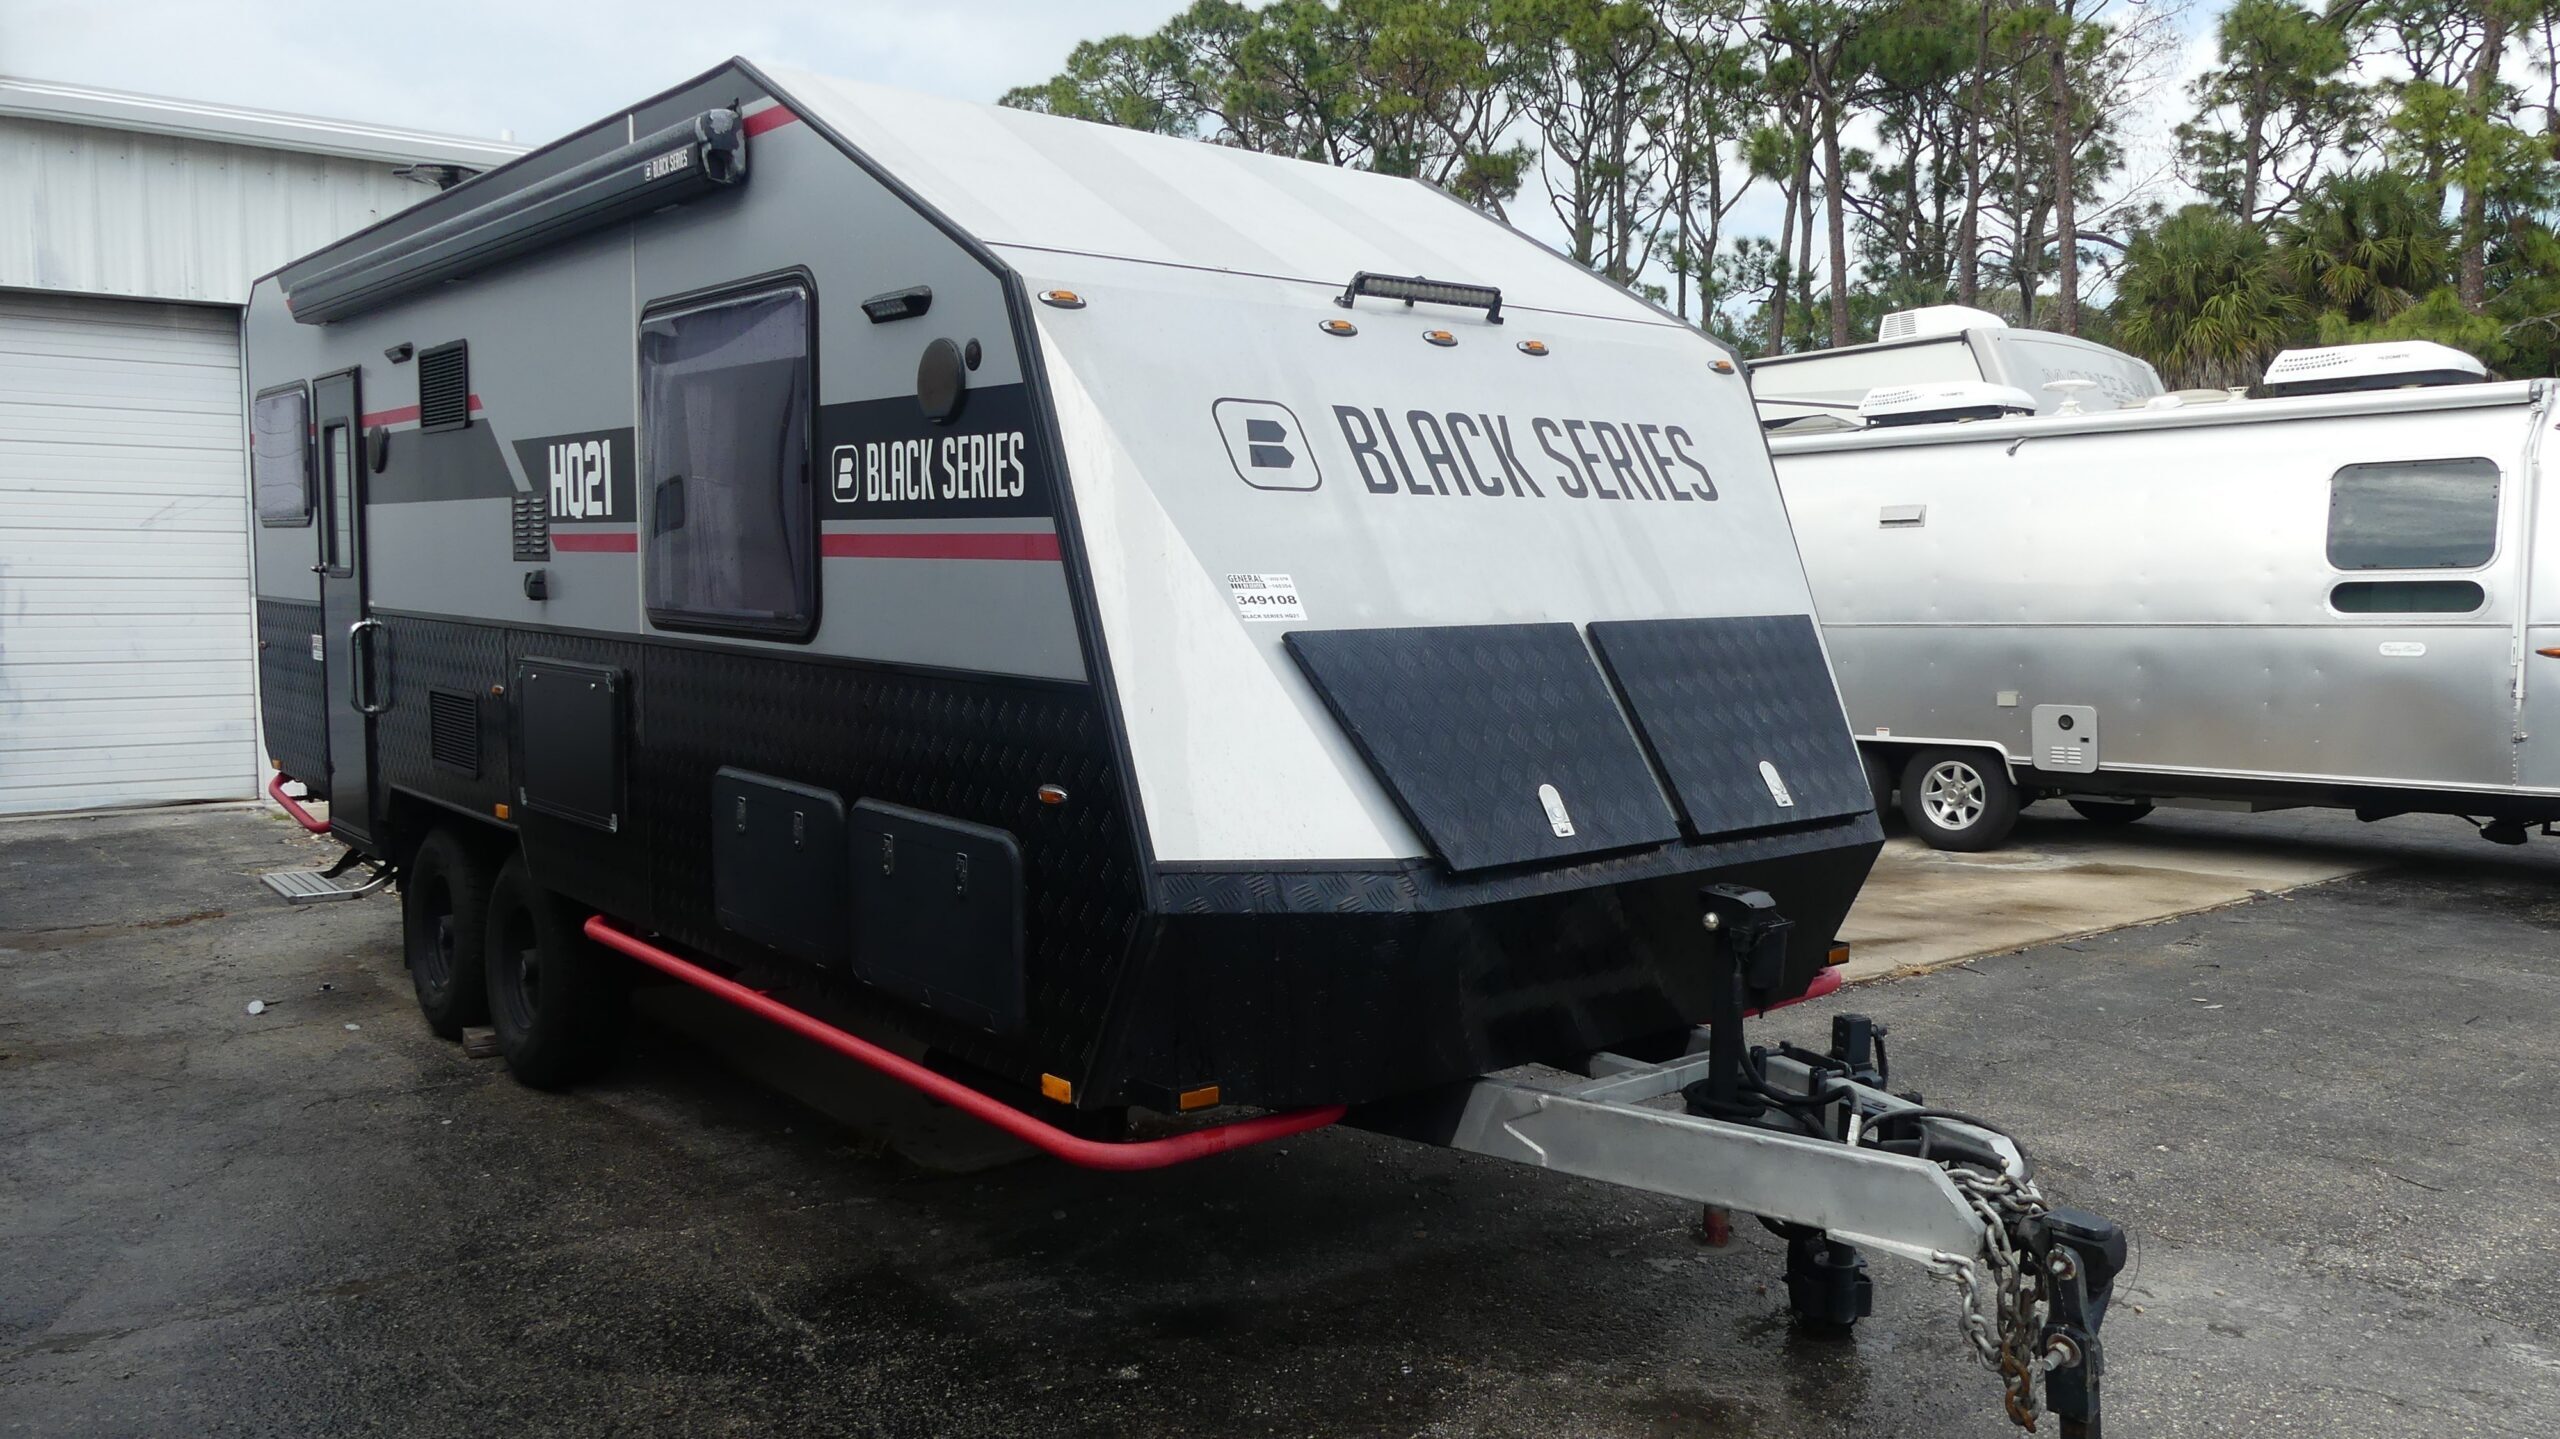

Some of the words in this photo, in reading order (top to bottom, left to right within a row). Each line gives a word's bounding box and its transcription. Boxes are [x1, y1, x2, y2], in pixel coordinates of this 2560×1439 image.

[652, 156, 670, 179] BLACK
[669, 148, 688, 172] SERIES
[866, 438, 935, 502] BLACK
[942, 431, 1025, 500] SERIES
[1332, 405, 1545, 498] BLACK
[1531, 417, 1719, 501] SERIES
[549, 439, 612, 519] HQ21
[1227, 574, 1264, 583] GENERAL
[1236, 595, 1297, 605] 349108
